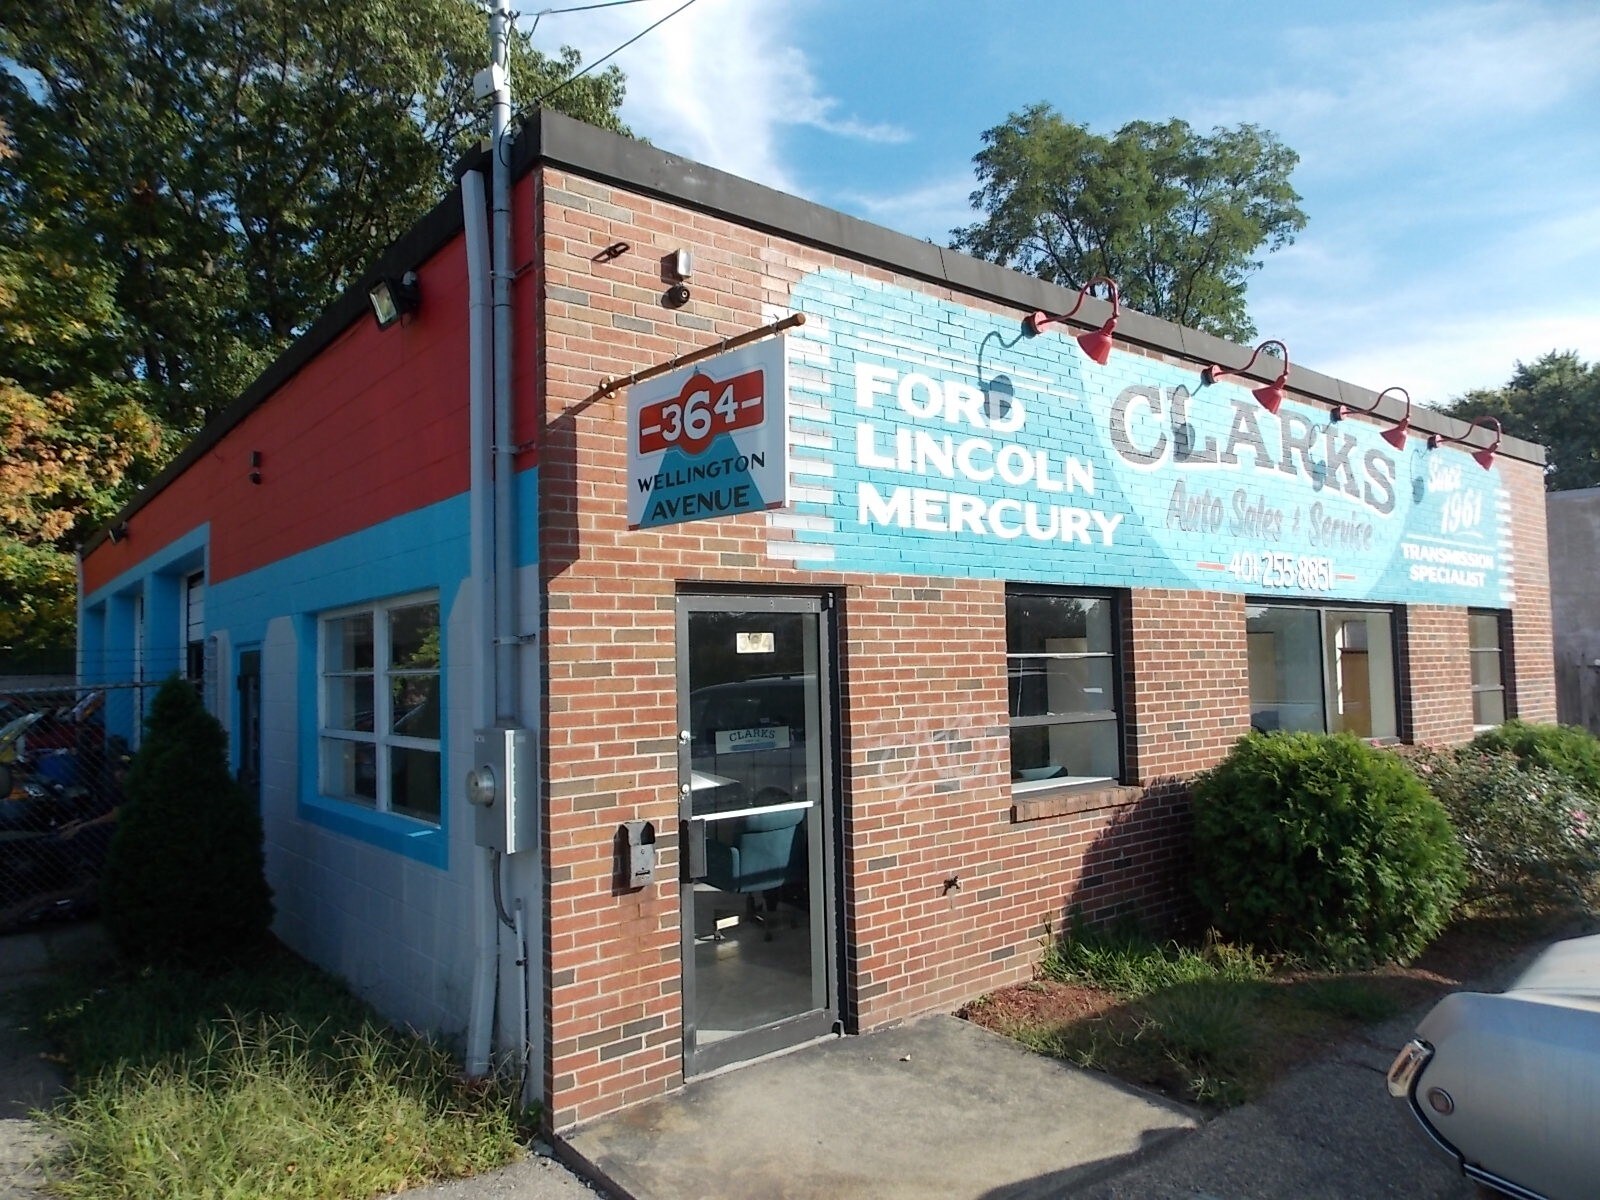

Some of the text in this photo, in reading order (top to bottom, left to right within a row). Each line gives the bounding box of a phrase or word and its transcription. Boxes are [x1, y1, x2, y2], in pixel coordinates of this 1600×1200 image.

[855, 361, 1026, 433] FORD
[637, 451, 766, 493] WELLINGTON
[856, 422, 1095, 496] LINCOLN
[1108, 384, 1397, 517] CLARKS
[651, 485, 750, 520] AVENUE
[857, 482, 1123, 547] MERCURY
[1166, 478, 1224, 534] Auto
[1229, 487, 1284, 542] Sales
[1308, 500, 1374, 551] Service
[1441, 488, 1482, 535] 1961
[1401, 542, 1494, 570] TRANSMISSION
[1409, 564, 1487, 588] SPECIALIST
[728, 728, 776, 742] CLARKS
